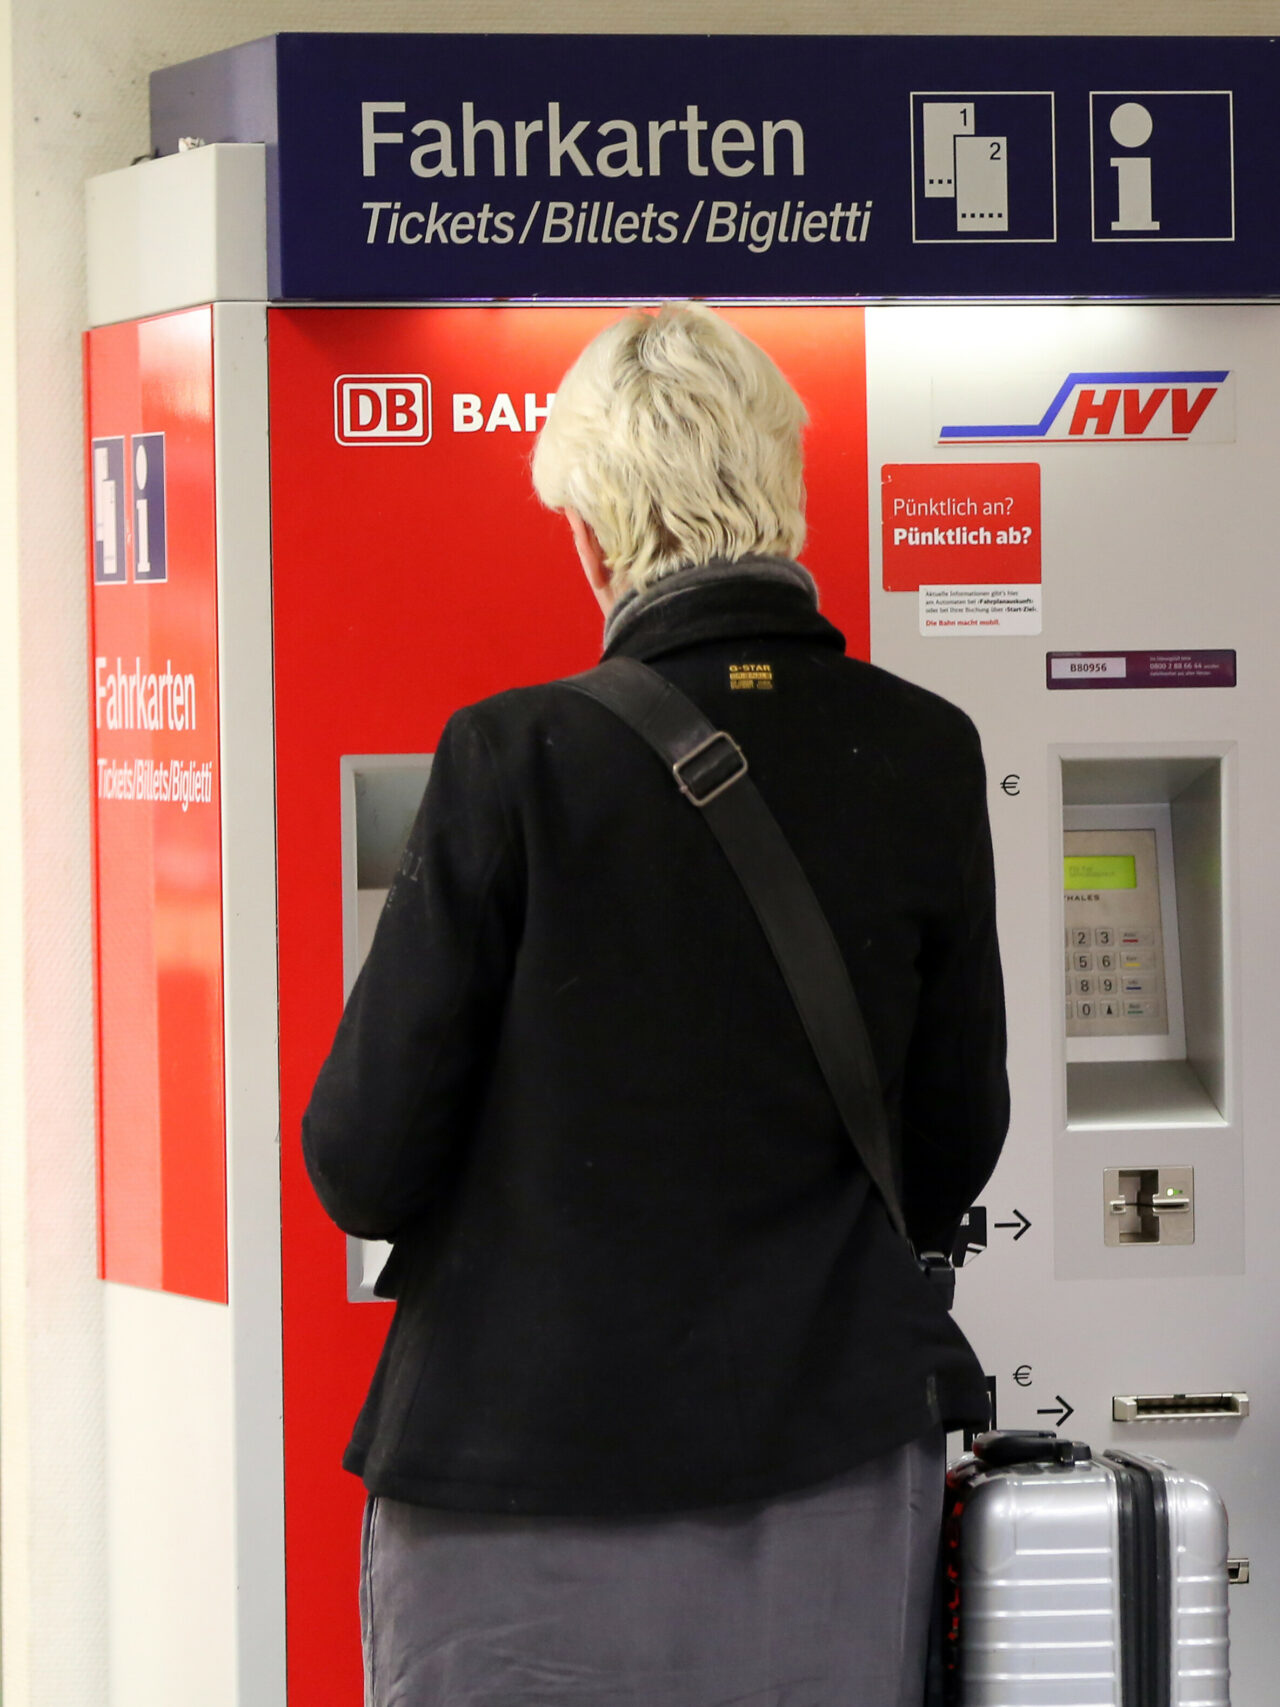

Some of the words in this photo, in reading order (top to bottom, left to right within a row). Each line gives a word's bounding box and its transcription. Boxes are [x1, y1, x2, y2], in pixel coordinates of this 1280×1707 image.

[959, 108, 968, 126] 1
[362, 101, 804, 178] Fahrkarten
[989, 142, 1001, 160] 2
[345, 384, 422, 435] DB
[452, 393, 556, 433] BAH
[1068, 387, 1218, 436] HVV
[893, 497, 978, 517] Pünktlich
[982, 496, 1014, 516] an?
[893, 527, 992, 546] Pünktlich
[996, 526, 1032, 545] ab?
[729, 664, 771, 672] G-STAR
[1070, 663, 1107, 673] B80956
[96, 656, 197, 731] Fahrkarten
[1064, 894, 1100, 902] HALES
[1077, 931, 1086, 945] 2
[1100, 931, 1109, 945] 3
[1079, 955, 1088, 968] 5
[1102, 955, 1111, 968] 6
[1080, 979, 1090, 993] 8
[1103, 979, 1112, 992] 9
[1082, 1003, 1091, 1016] 0
